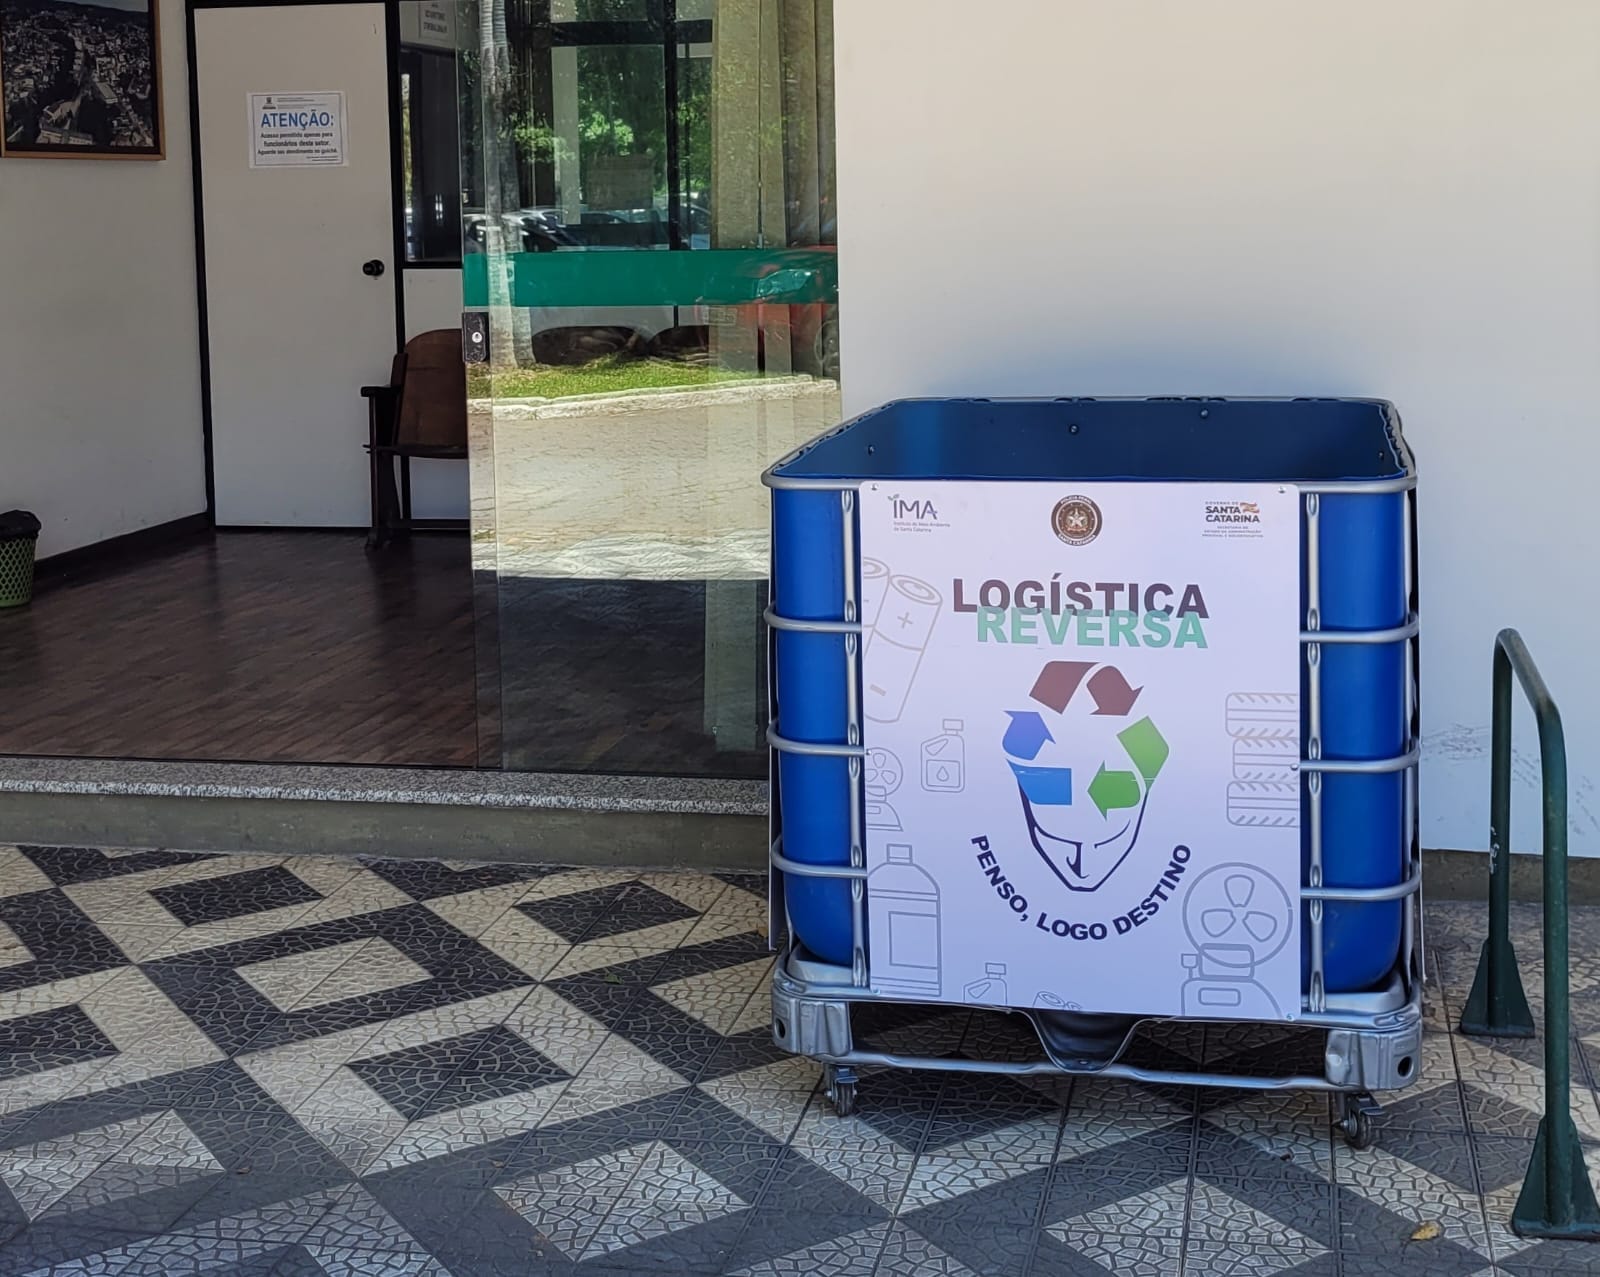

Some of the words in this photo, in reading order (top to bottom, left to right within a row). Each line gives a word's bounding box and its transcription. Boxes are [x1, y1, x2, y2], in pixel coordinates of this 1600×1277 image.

[261, 109, 334, 130] ATENÇÃO:
[893, 500, 938, 520] IMA
[1205, 506, 1241, 514] SANTA
[1205, 514, 1260, 523] CATARINA
[953, 572, 1209, 618] LOGÍSTICA
[977, 606, 1208, 648] REVERSA
[971, 835, 1028, 922] PENSO,
[1036, 912, 1108, 940] LOGO
[1112, 844, 1191, 935] DESTINO
